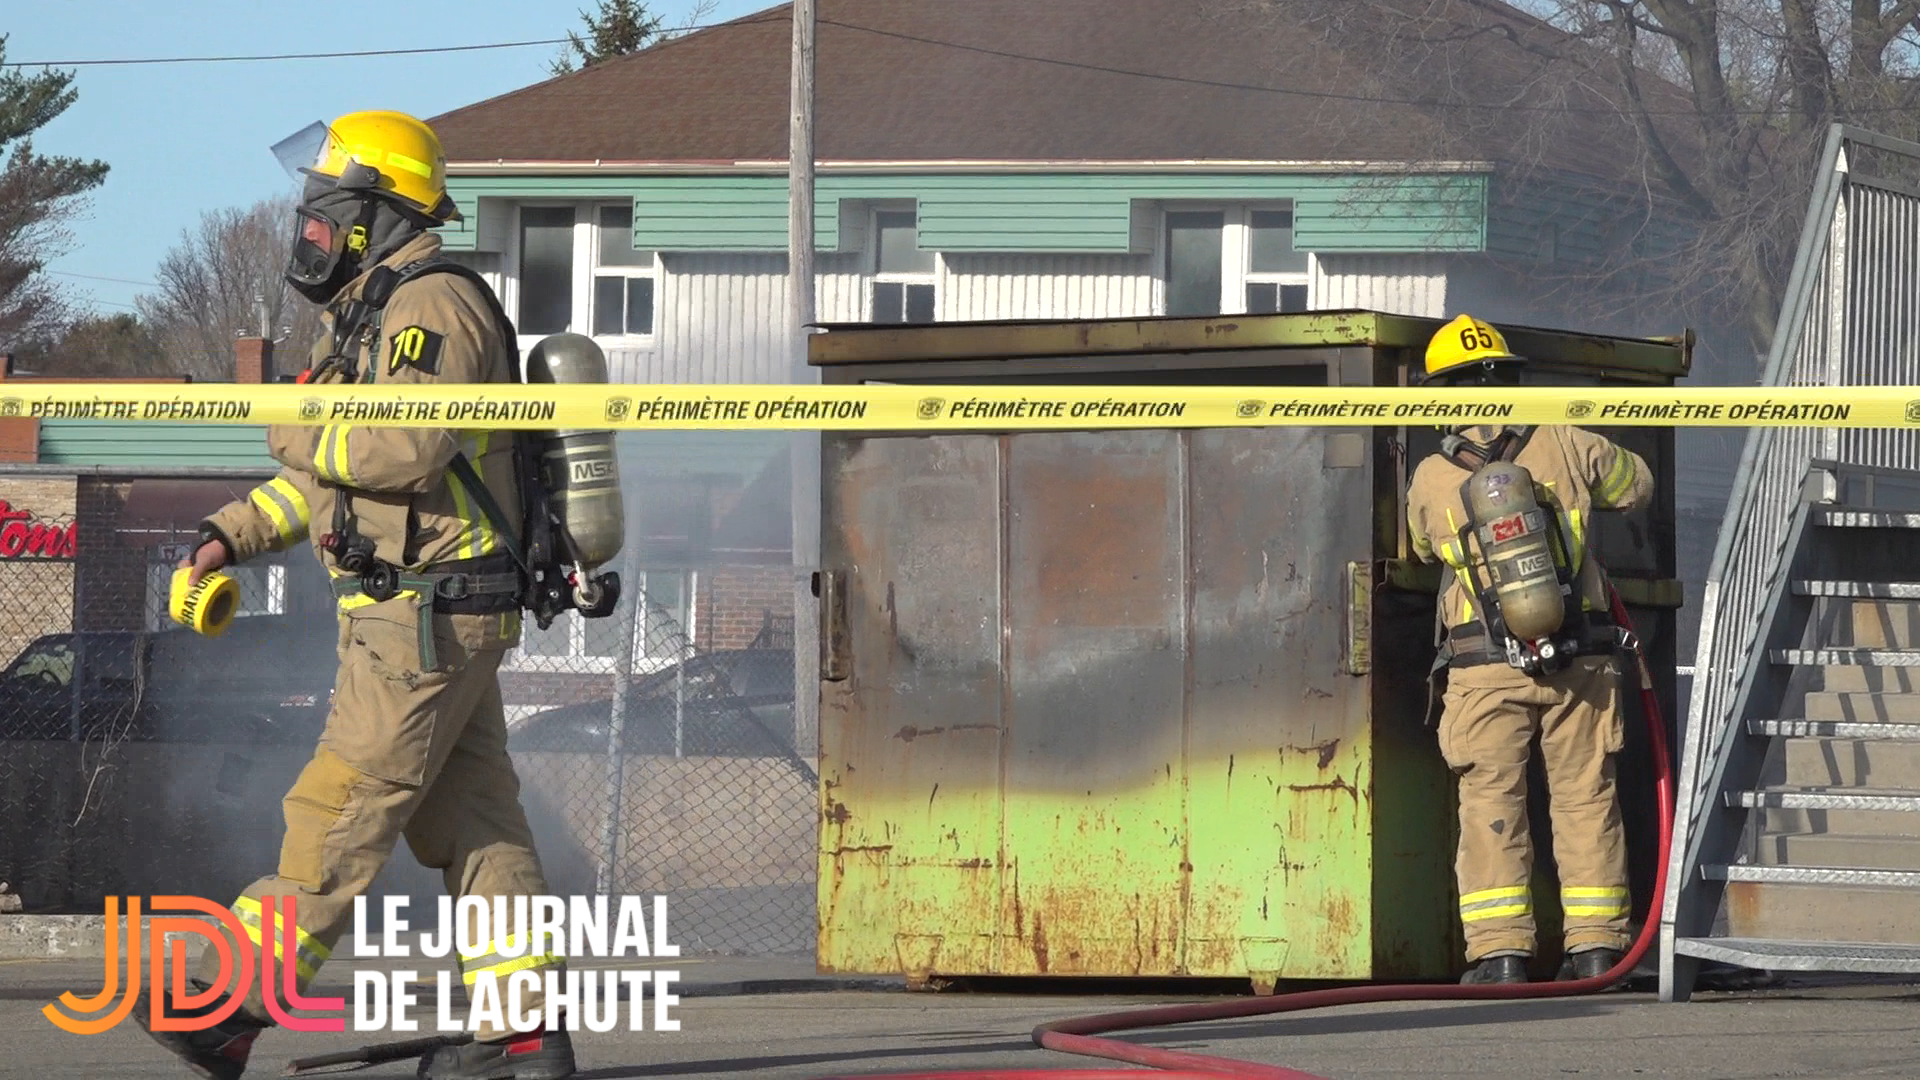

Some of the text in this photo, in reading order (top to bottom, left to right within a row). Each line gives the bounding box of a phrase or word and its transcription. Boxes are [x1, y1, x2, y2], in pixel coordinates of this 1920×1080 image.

[391, 327, 425, 369] 10
[1460, 327, 1493, 351] 65
[30, 396, 251, 418] PÉRIMÈTRE OPÉRATION
[330, 396, 556, 420] PÉRIMÈTRE OPÉRATION
[637, 396, 867, 420] PÉRIMÈTRE OPÉRATION
[949, 398, 1186, 418] PÉRIMÈTRE OPÉRATION
[1269, 400, 1513, 417] PÉRIMÈTRE OPÉRATION
[1600, 400, 1850, 420] PÉRIMÈTRE OPÉRATION
[1521, 555, 1548, 574] MS
